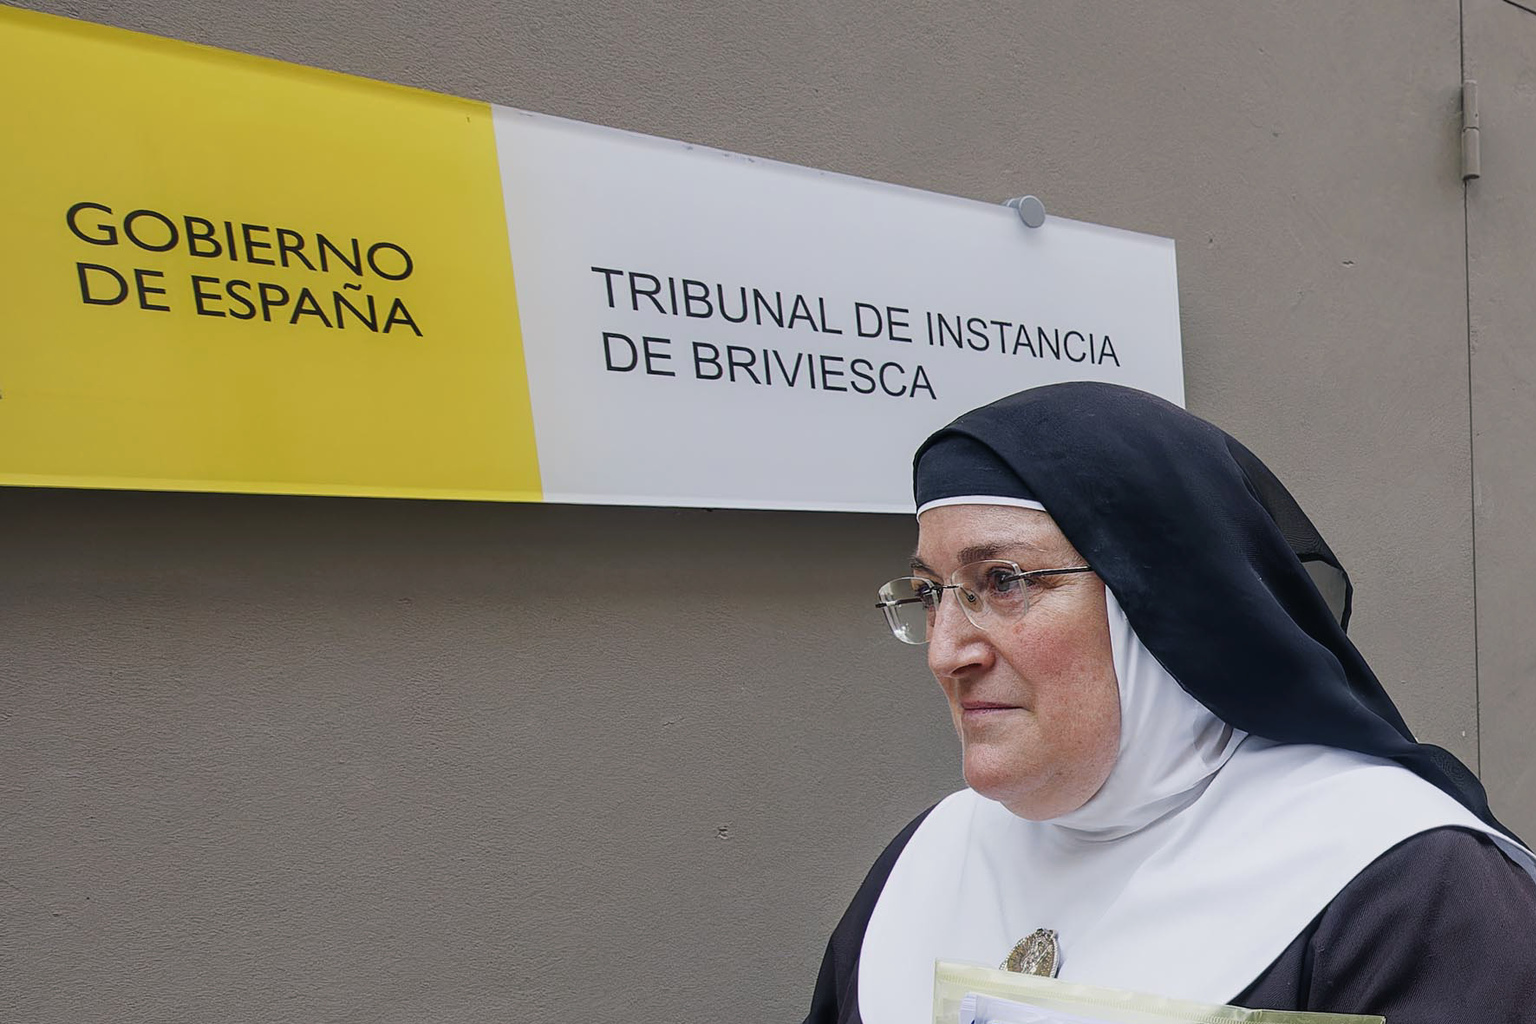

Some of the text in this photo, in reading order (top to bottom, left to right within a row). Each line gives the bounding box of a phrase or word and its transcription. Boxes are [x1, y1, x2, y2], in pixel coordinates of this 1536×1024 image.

[66, 202, 413, 281] GOBIERNO
[76, 262, 423, 337] DE ESPAÑA
[591, 267, 1120, 367] TRIBUNAL DE INSTANCIA
[603, 332, 936, 400] DE BRIVIESCA
